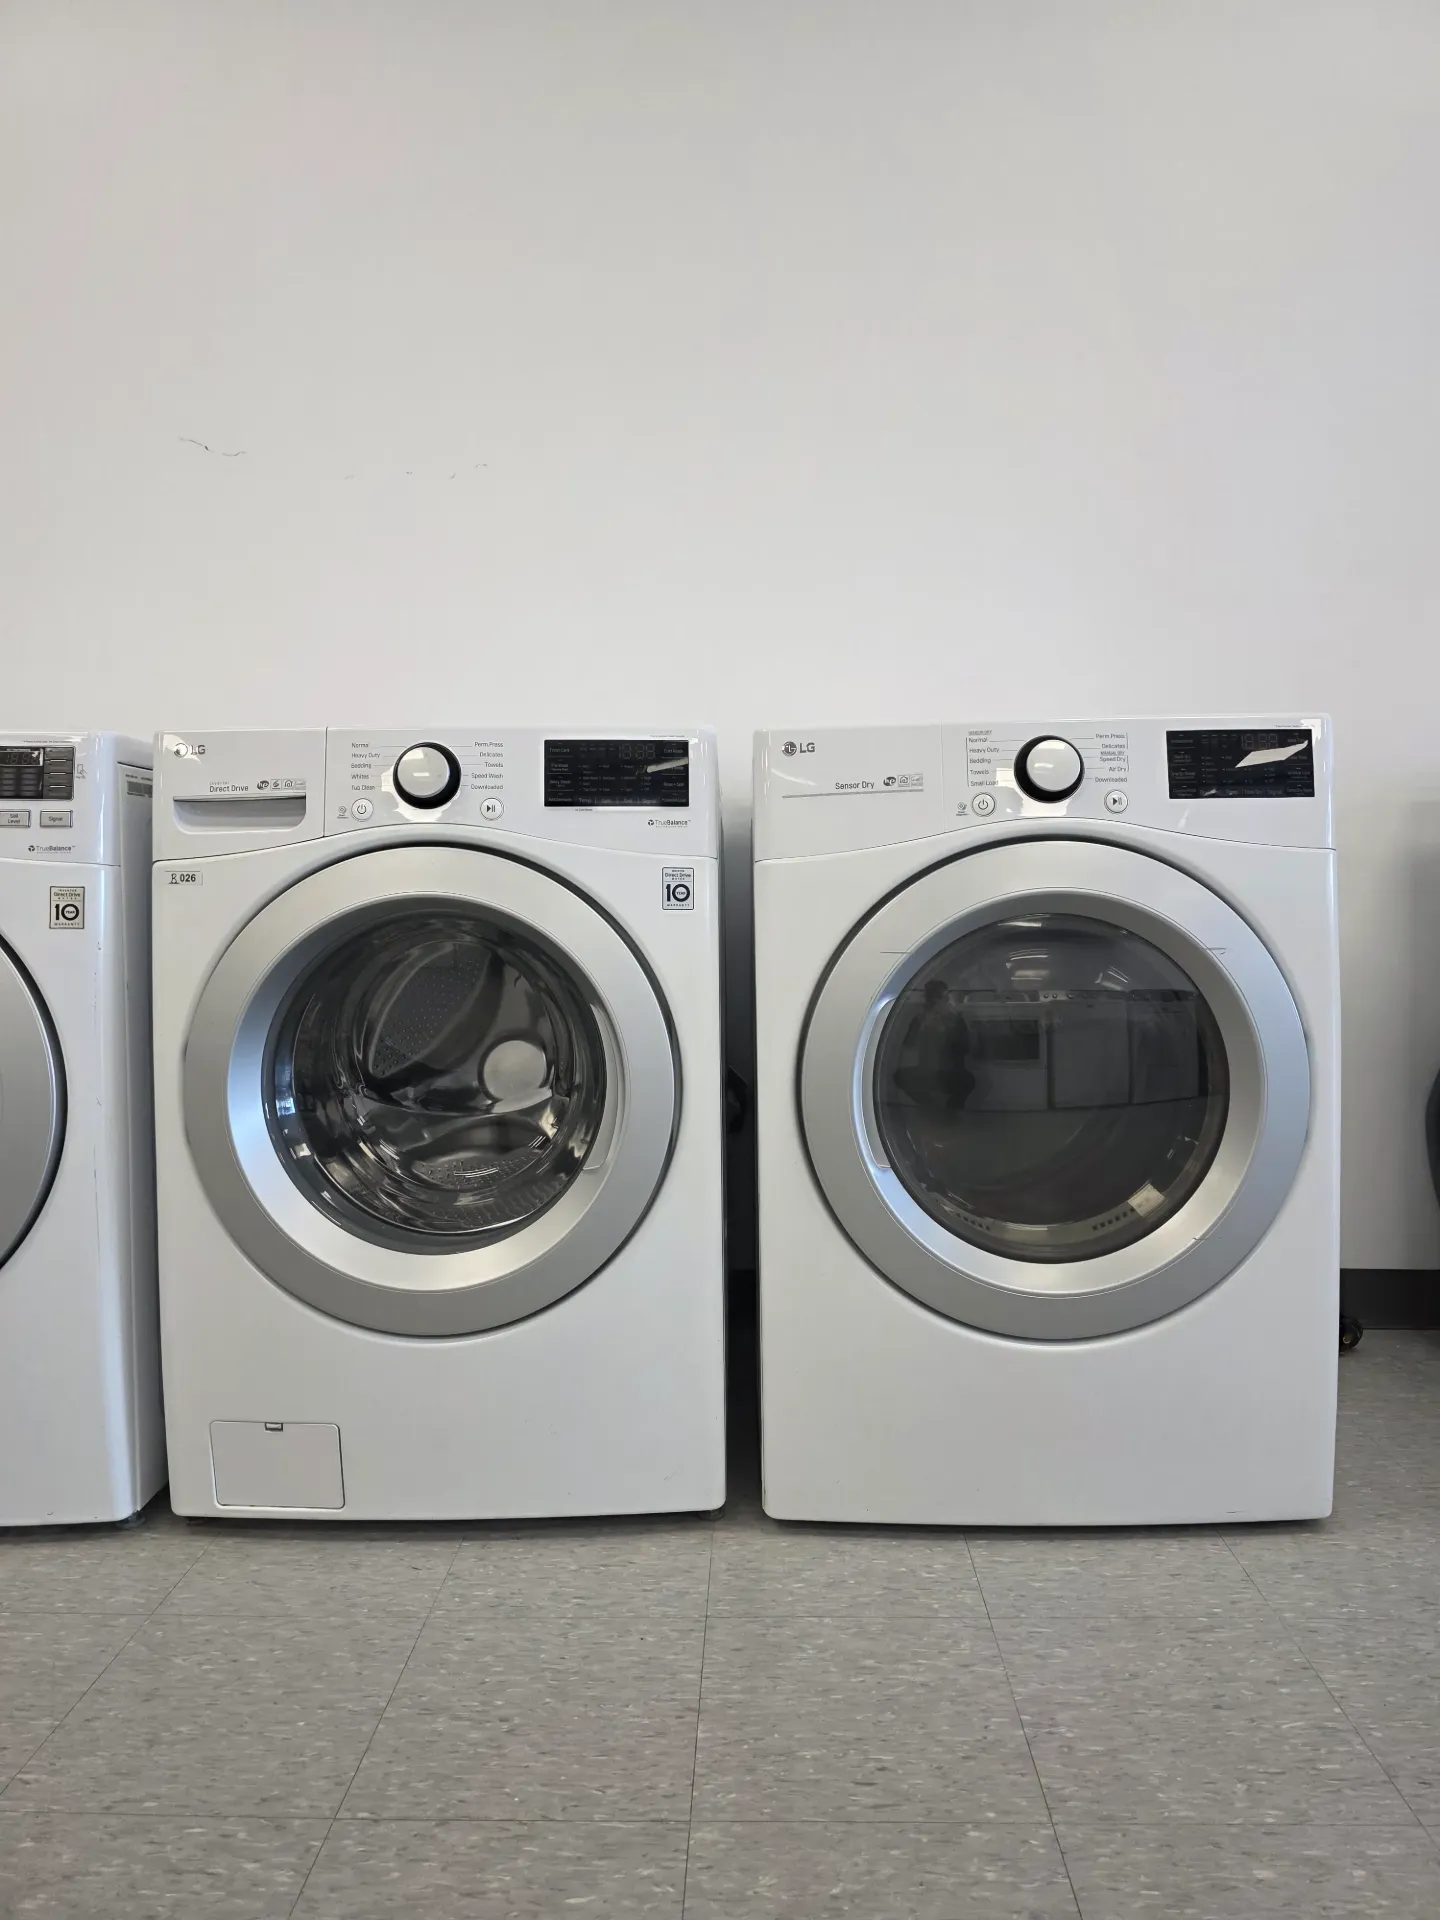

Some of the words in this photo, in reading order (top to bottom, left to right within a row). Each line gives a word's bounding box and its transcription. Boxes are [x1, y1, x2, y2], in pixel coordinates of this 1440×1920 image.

[799, 742, 816, 754] LG
[209, 785, 230, 793] Direct
[231, 784, 249, 792] Drive
[835, 781, 860, 790] Sensor
[861, 780, 875, 789] Dry
[180, 873, 197, 883] 026
[665, 883, 691, 902] 10
[54, 903, 80, 921] 10
